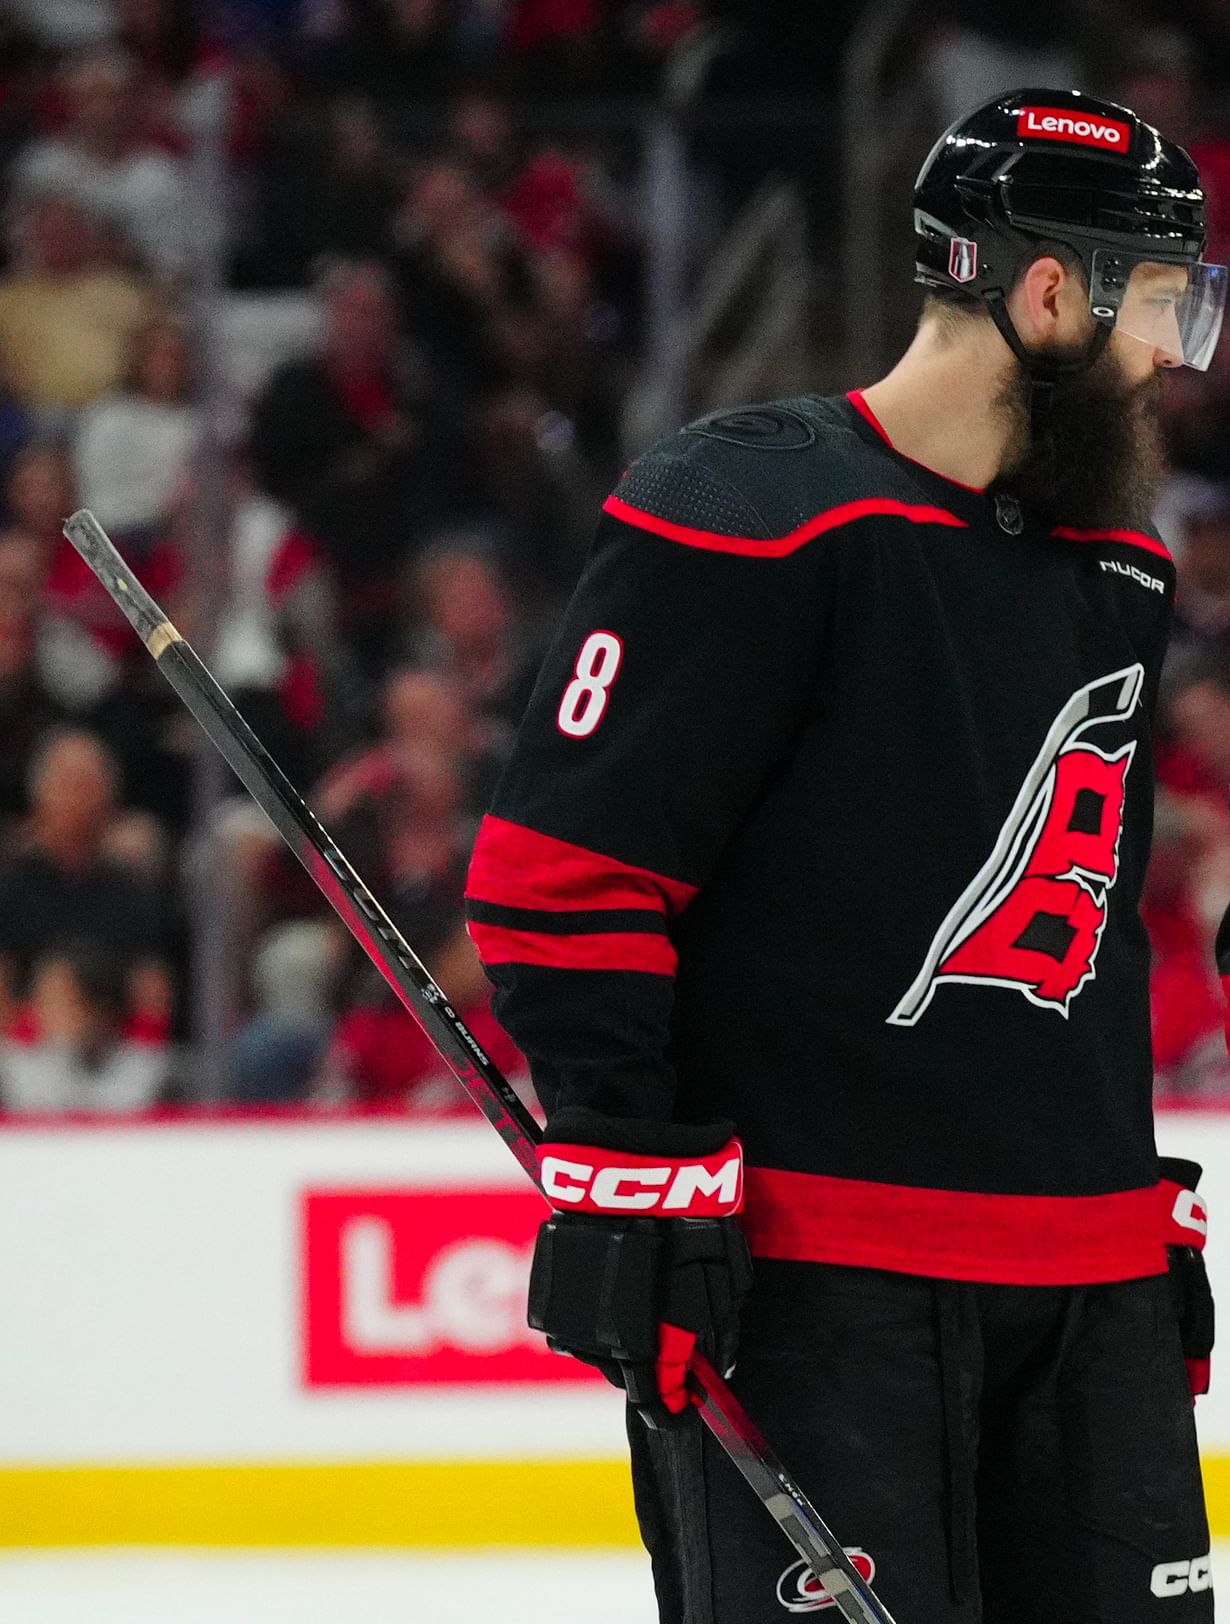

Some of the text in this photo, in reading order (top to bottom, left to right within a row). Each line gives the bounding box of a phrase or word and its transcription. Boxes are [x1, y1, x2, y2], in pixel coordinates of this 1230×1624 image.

[1027, 112, 1121, 143] Lenovo
[1099, 560, 1165, 595] NUCOR
[555, 628, 625, 740] 8
[454, 1021, 490, 1067] BURNS
[540, 1156, 741, 1210] CCM
